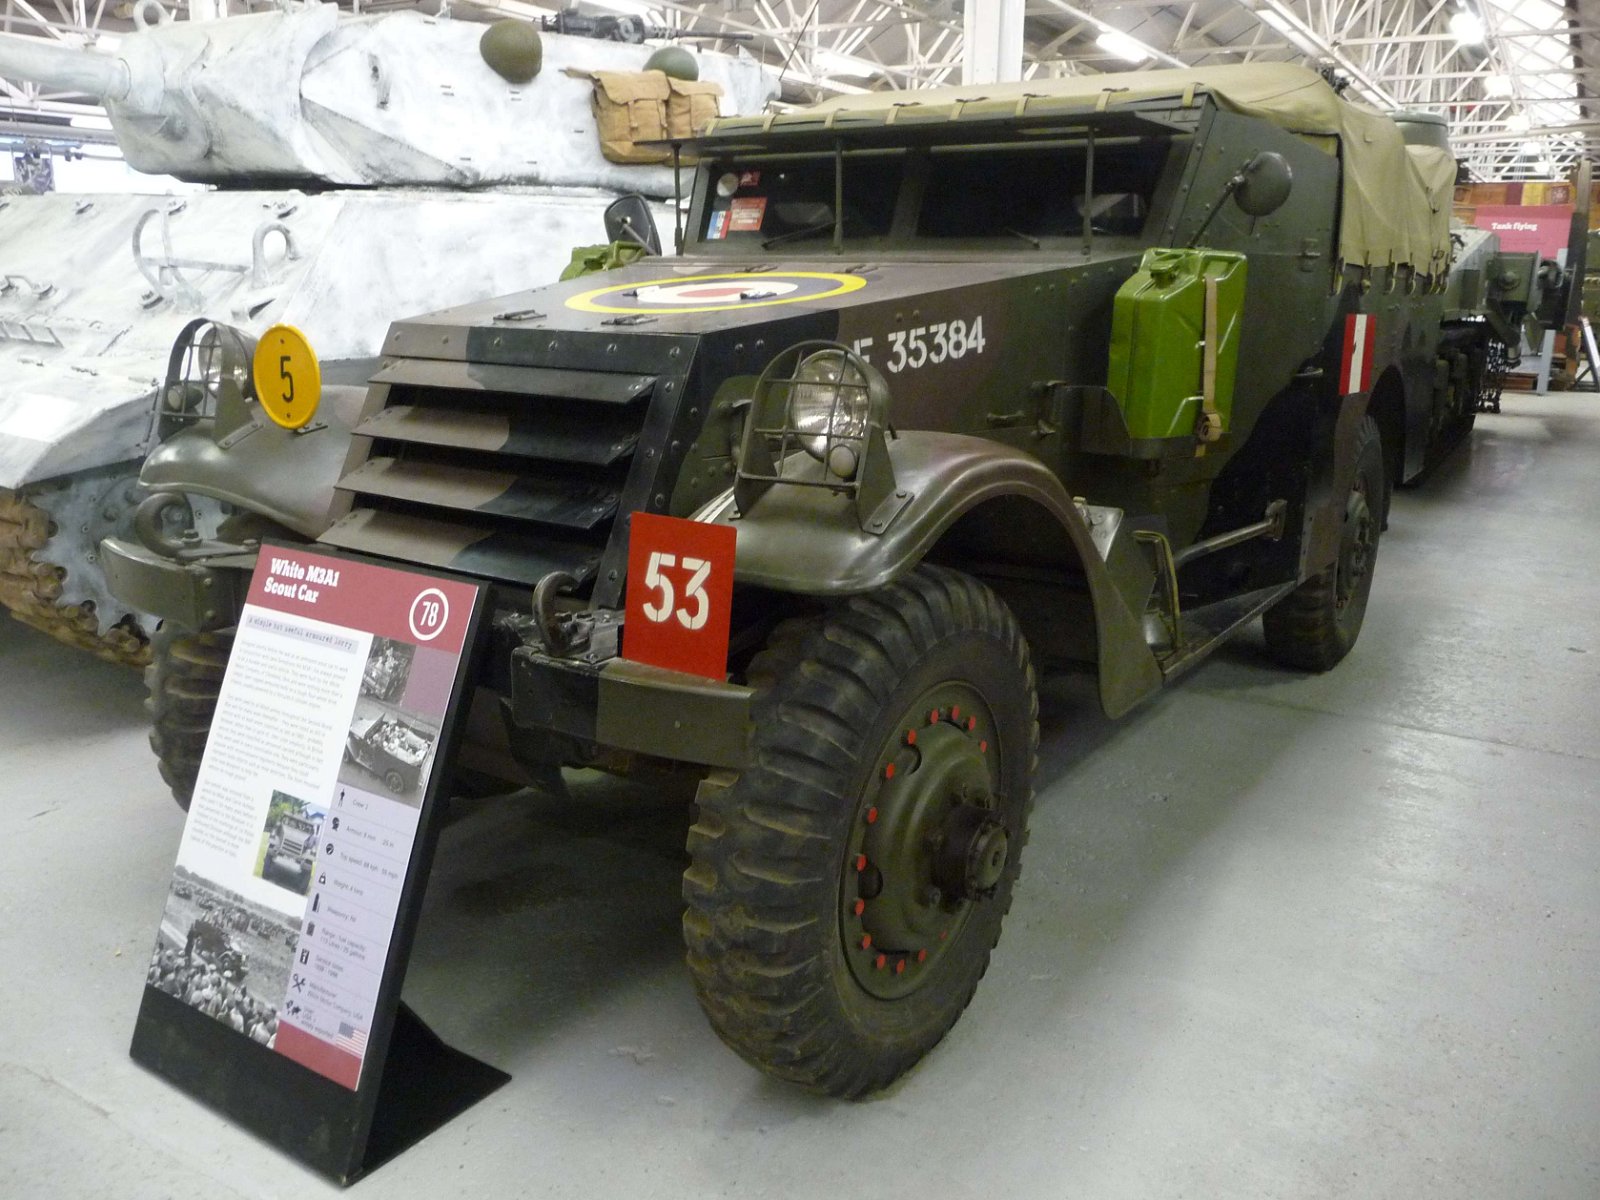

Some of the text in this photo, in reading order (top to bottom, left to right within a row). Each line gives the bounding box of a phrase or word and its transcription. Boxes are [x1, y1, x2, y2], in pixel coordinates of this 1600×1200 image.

[1491, 222, 1538, 232] Tank flying
[887, 315, 986, 374] 35384
[280, 355, 294, 403] 5
[270, 557, 341, 588] White M3A1
[263, 575, 320, 604] Scout Car
[642, 551, 712, 631] 53
[420, 600, 440, 628] 78
